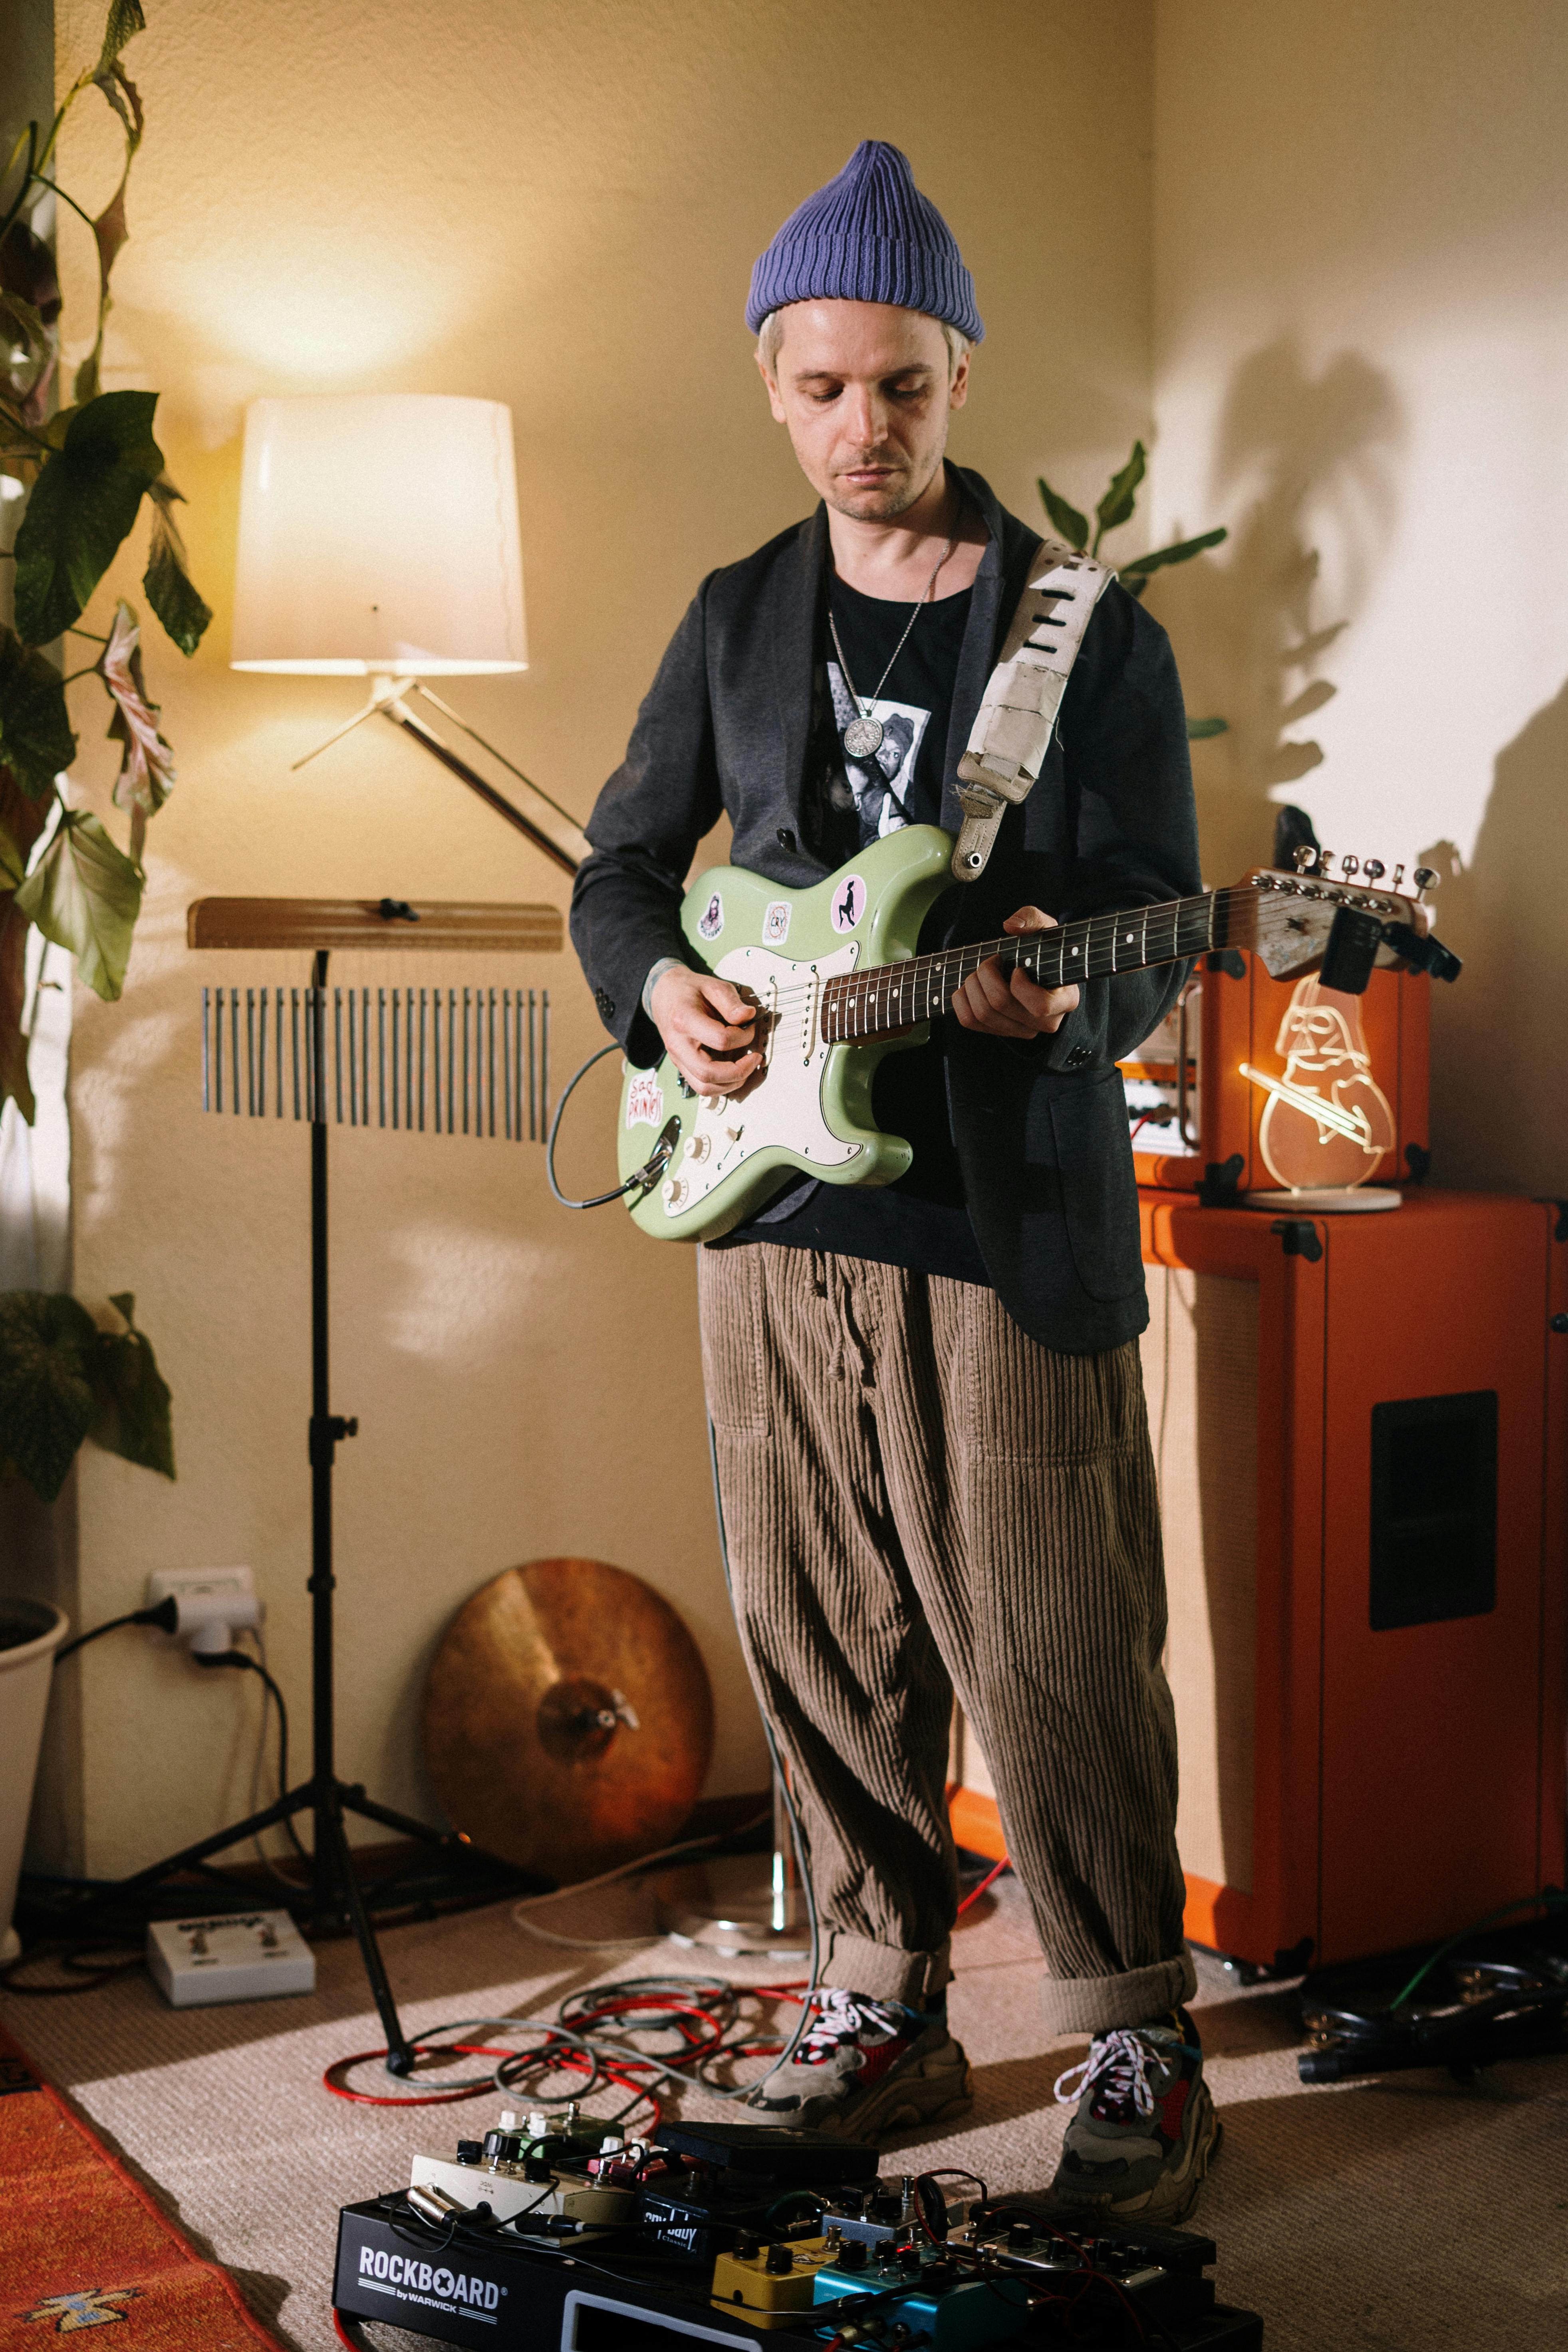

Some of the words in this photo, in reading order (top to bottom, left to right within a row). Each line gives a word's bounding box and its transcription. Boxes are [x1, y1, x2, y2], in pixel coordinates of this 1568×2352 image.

[630, 1072, 655, 1098] Sad
[662, 2235, 687, 2248] Classic
[397, 2289, 408, 2300] by
[408, 2292, 457, 2313] WARWICK
